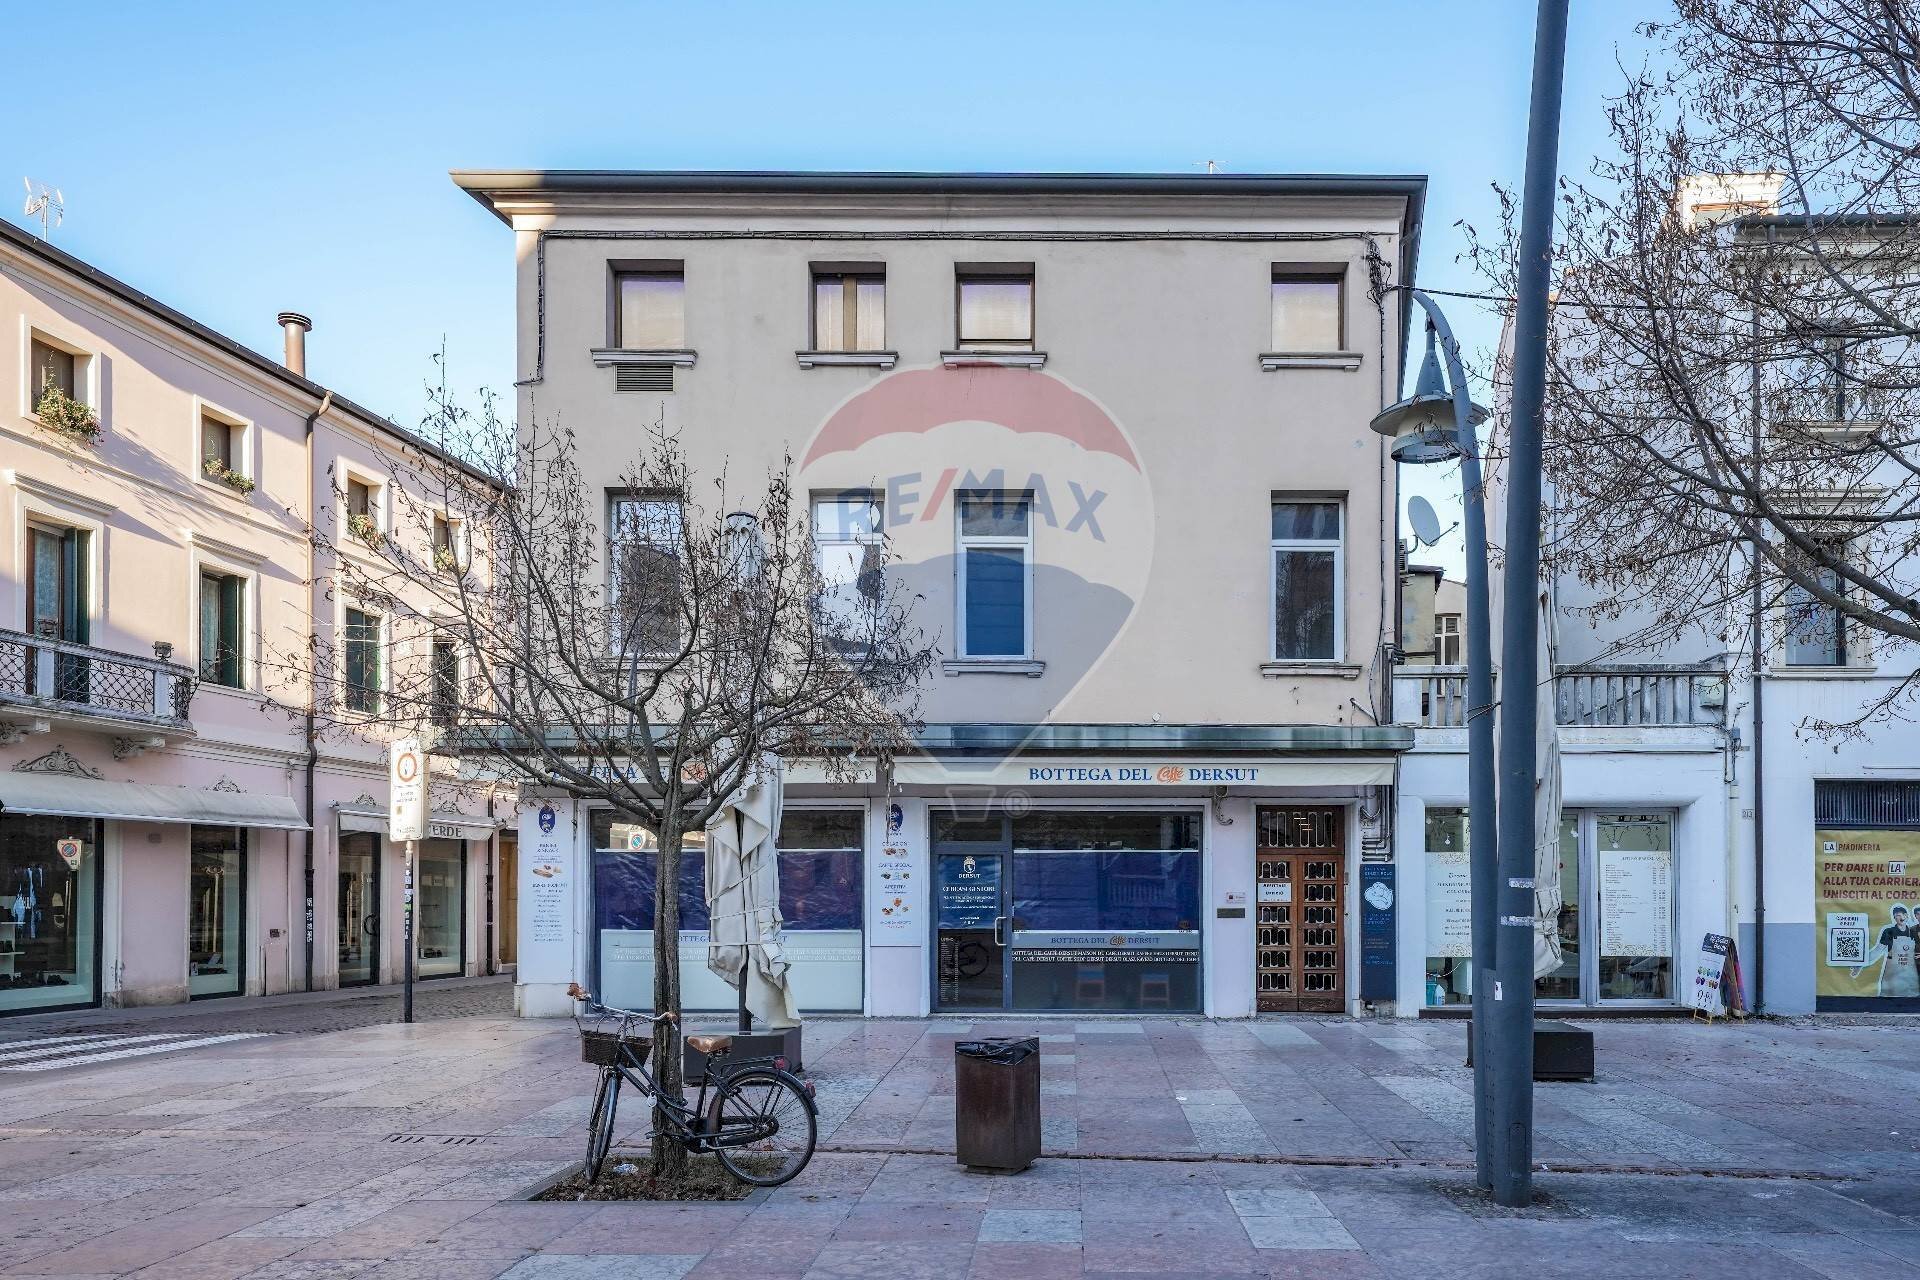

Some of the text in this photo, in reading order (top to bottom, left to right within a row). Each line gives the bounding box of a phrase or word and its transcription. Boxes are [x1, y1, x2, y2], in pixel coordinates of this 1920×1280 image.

[1029, 767, 1113, 781] BOTTEGA
[1118, 768, 1153, 781] DEL
[1188, 768, 1259, 781] DERSUT
[429, 824, 462, 838] ERDE
[1824, 843, 1881, 851] LA PIADINERIA
[1824, 863, 1844, 872] PER
[1846, 863, 1874, 873] DARE
[1876, 863, 1885, 873] IL
[1823, 876, 1920, 887] ALLA TUA CARRIER
[1823, 890, 1869, 899] UNISCITI
[1871, 890, 1883, 899] AL
